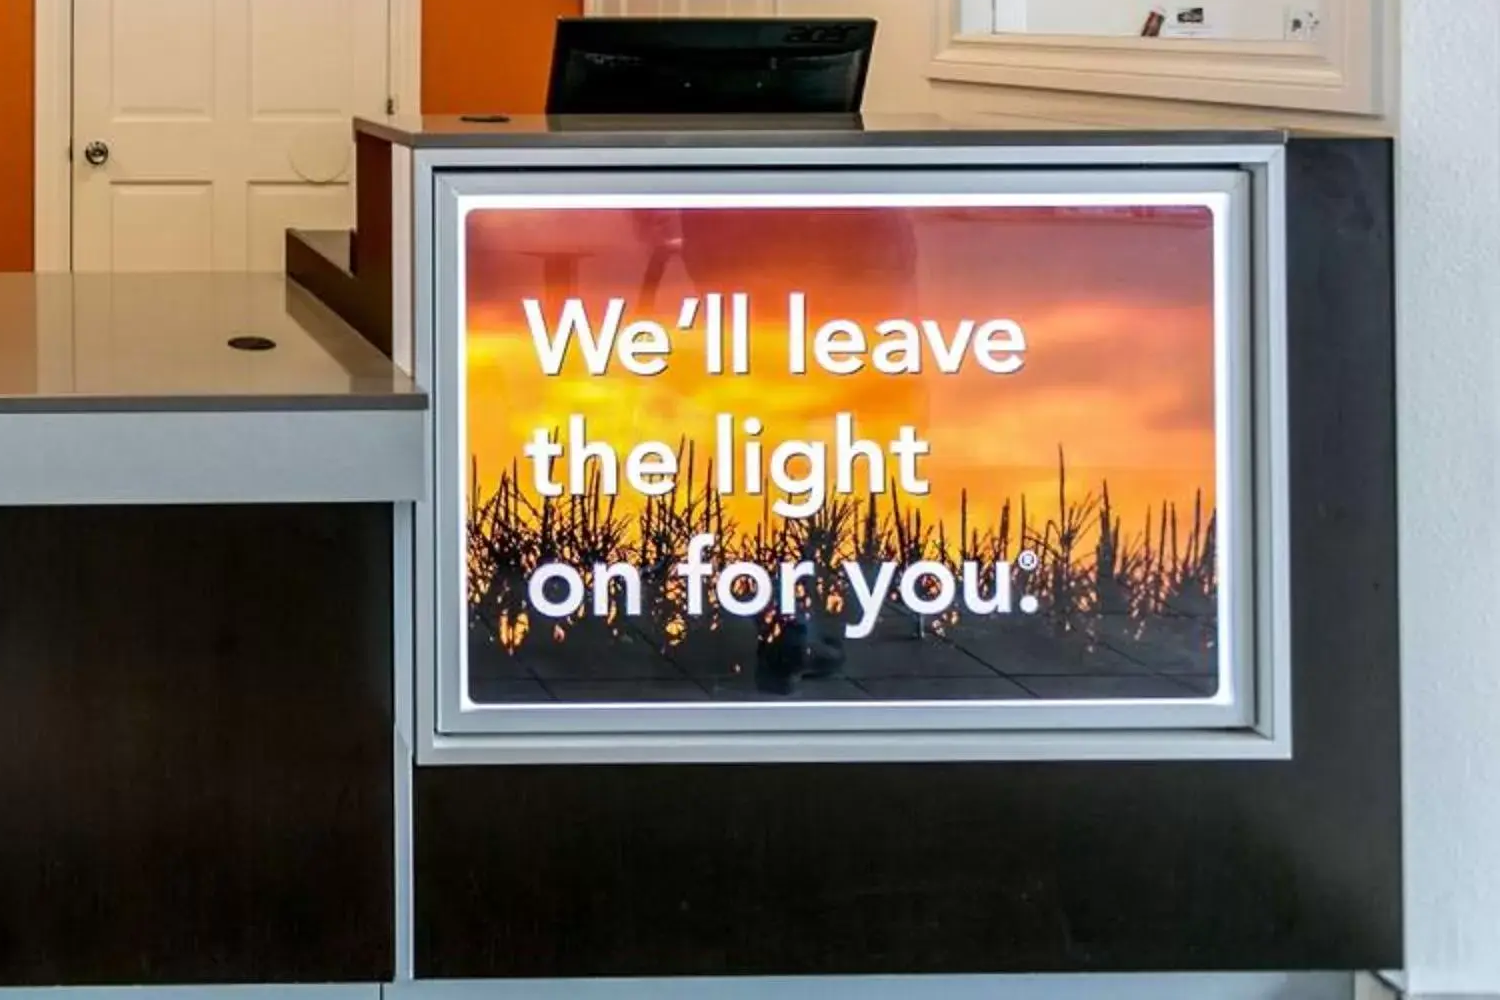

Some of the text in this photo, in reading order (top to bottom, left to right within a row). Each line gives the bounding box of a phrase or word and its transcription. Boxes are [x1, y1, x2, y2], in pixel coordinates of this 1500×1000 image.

[522, 293, 1027, 376] We’ll leave
[524, 412, 931, 519] the light
[527, 559, 642, 618] on
[678, 533, 814, 618] for
